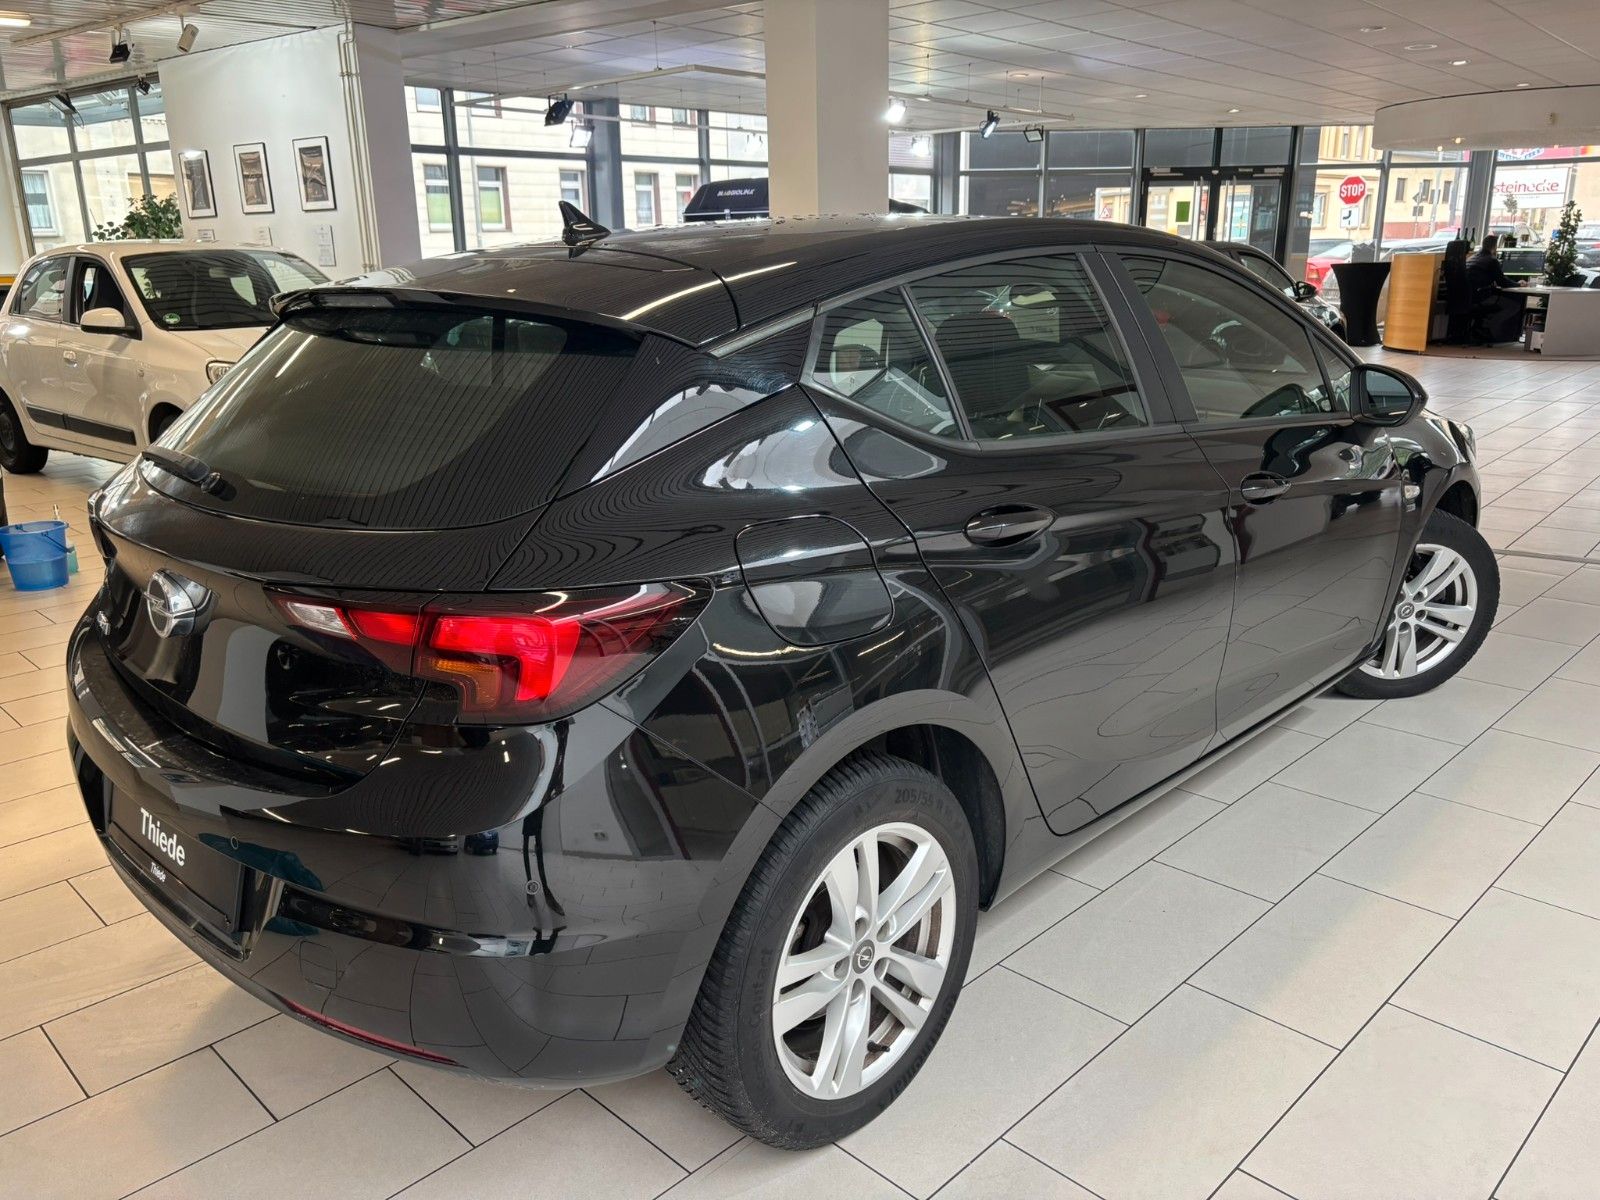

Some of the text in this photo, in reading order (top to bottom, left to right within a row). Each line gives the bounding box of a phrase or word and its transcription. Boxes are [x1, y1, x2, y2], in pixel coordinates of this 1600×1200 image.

[1340, 183, 1365, 198] STOP
[1493, 179, 1560, 194] steinecke
[140, 807, 186, 867] Thiede
[151, 861, 167, 883] Thiede
